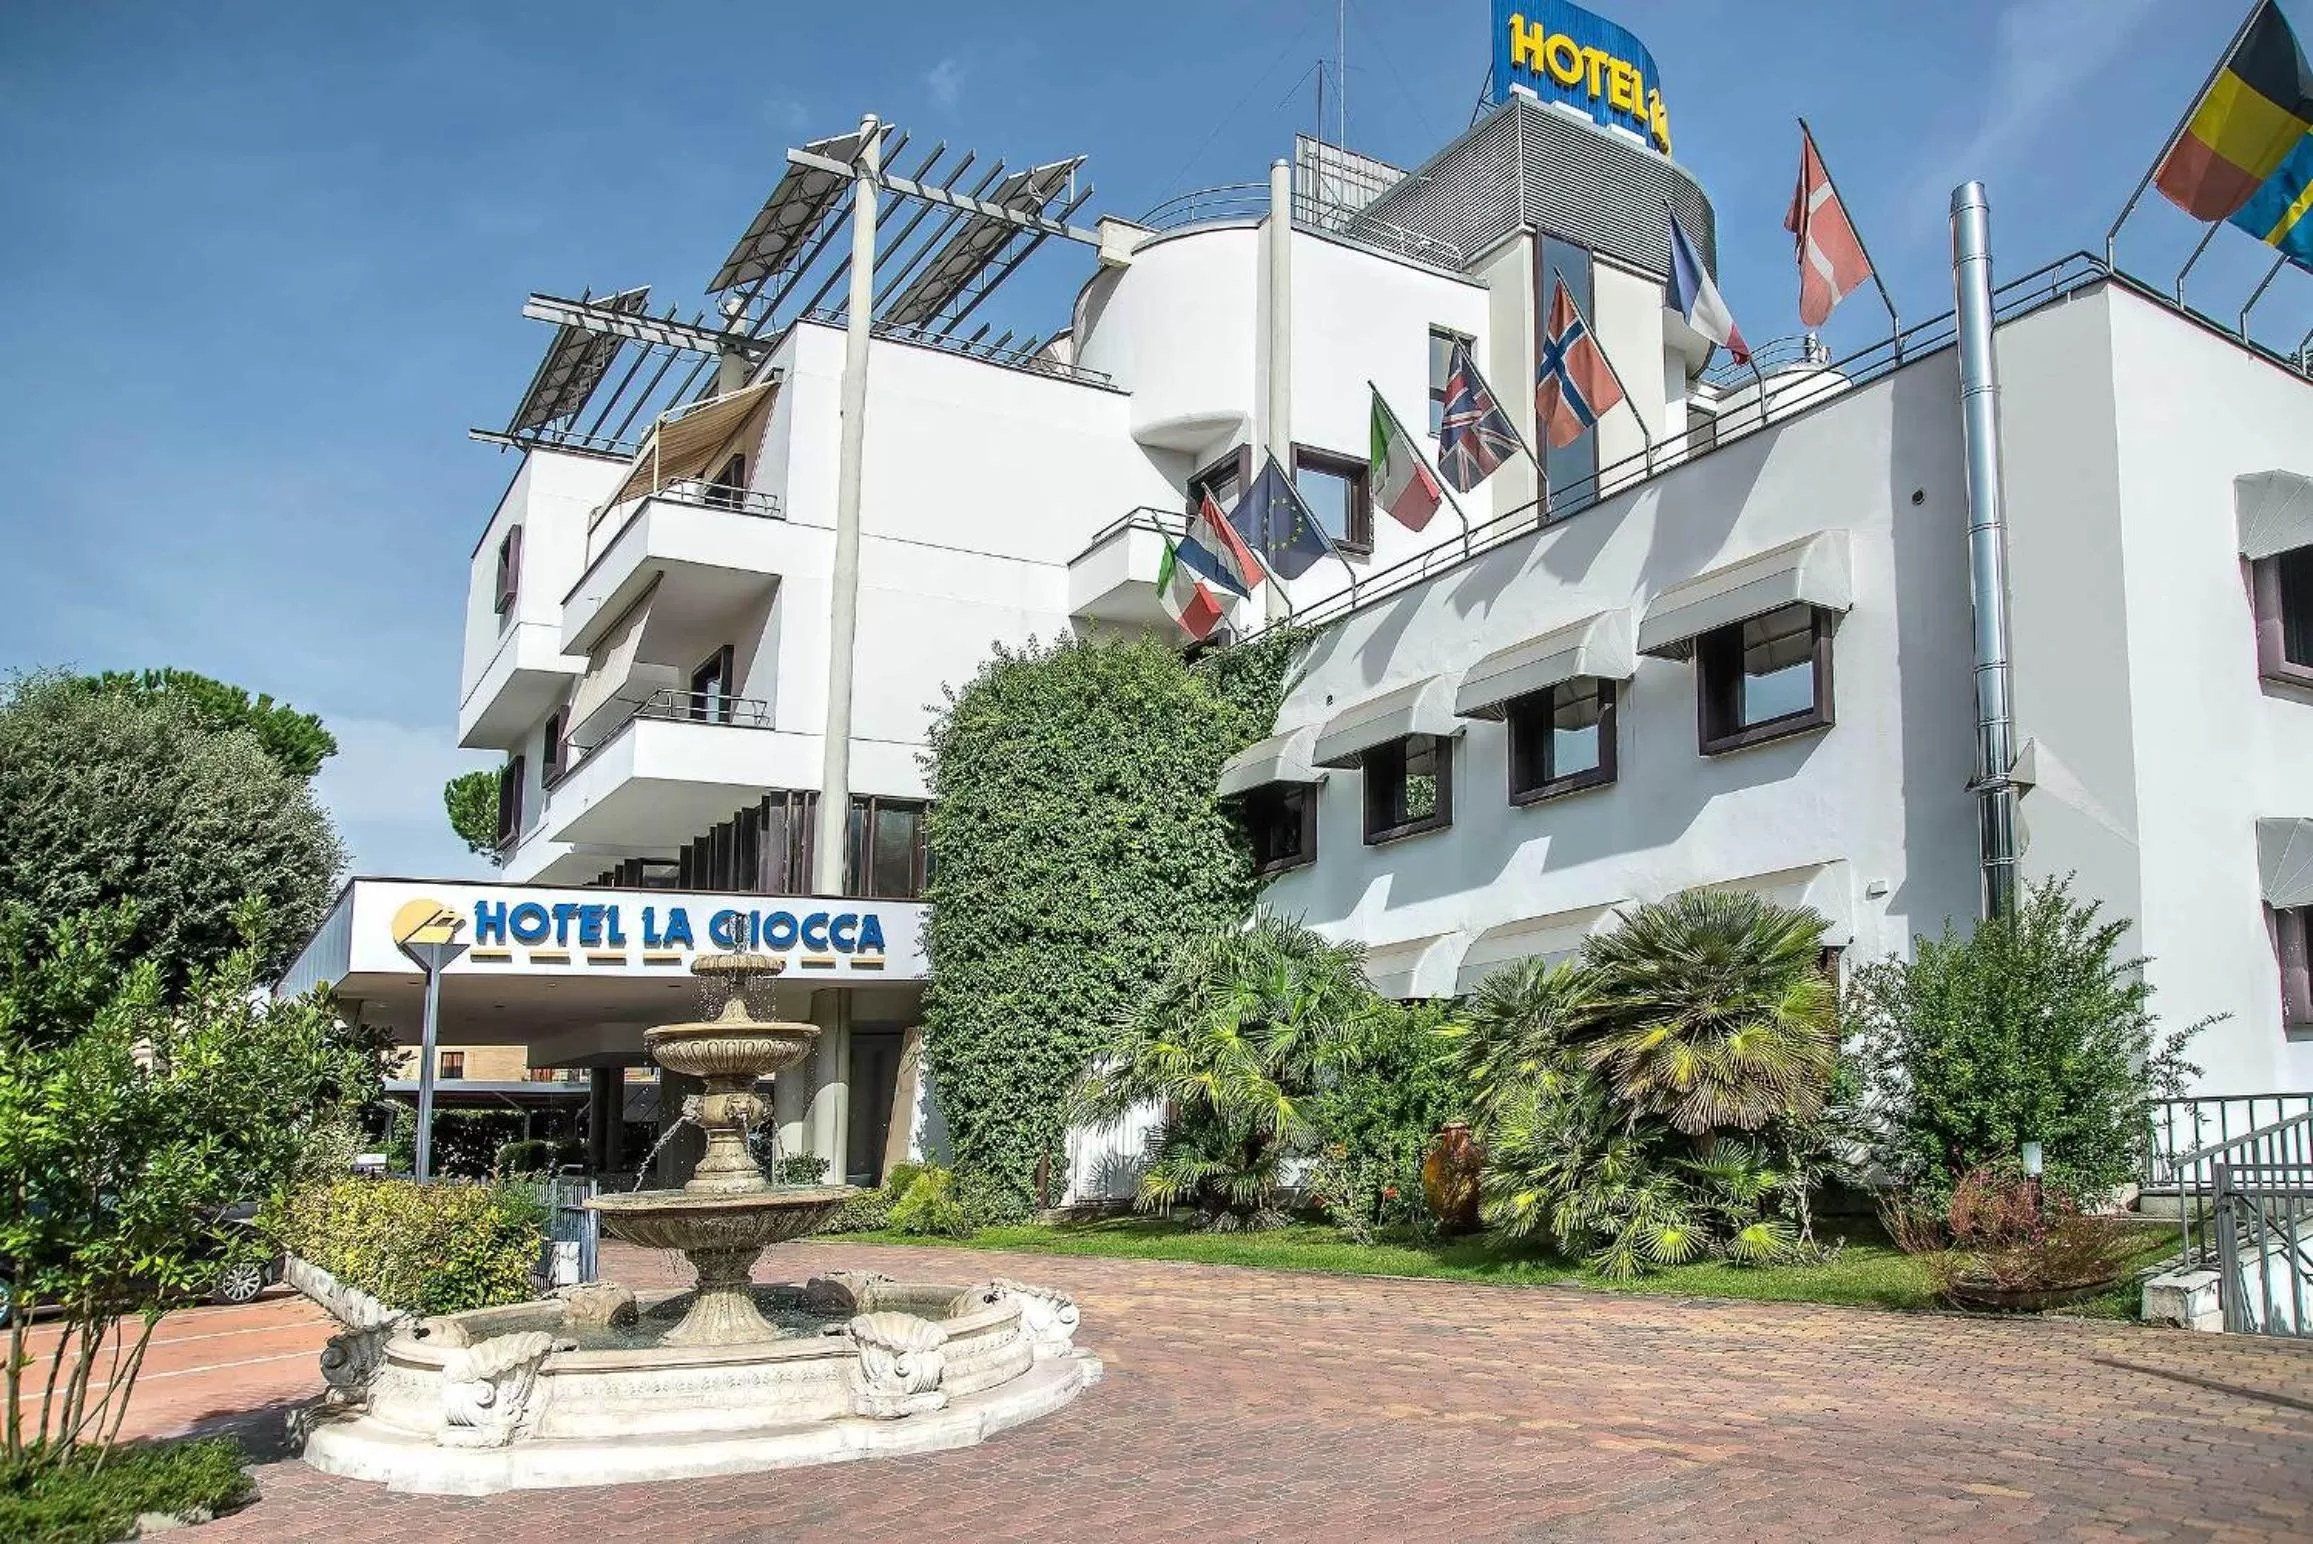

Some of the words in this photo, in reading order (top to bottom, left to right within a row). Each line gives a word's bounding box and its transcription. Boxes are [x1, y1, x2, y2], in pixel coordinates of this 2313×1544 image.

[1508, 13, 1649, 122] HOTEL
[475, 901, 626, 947] HOTEL
[642, 906, 694, 950] LA
